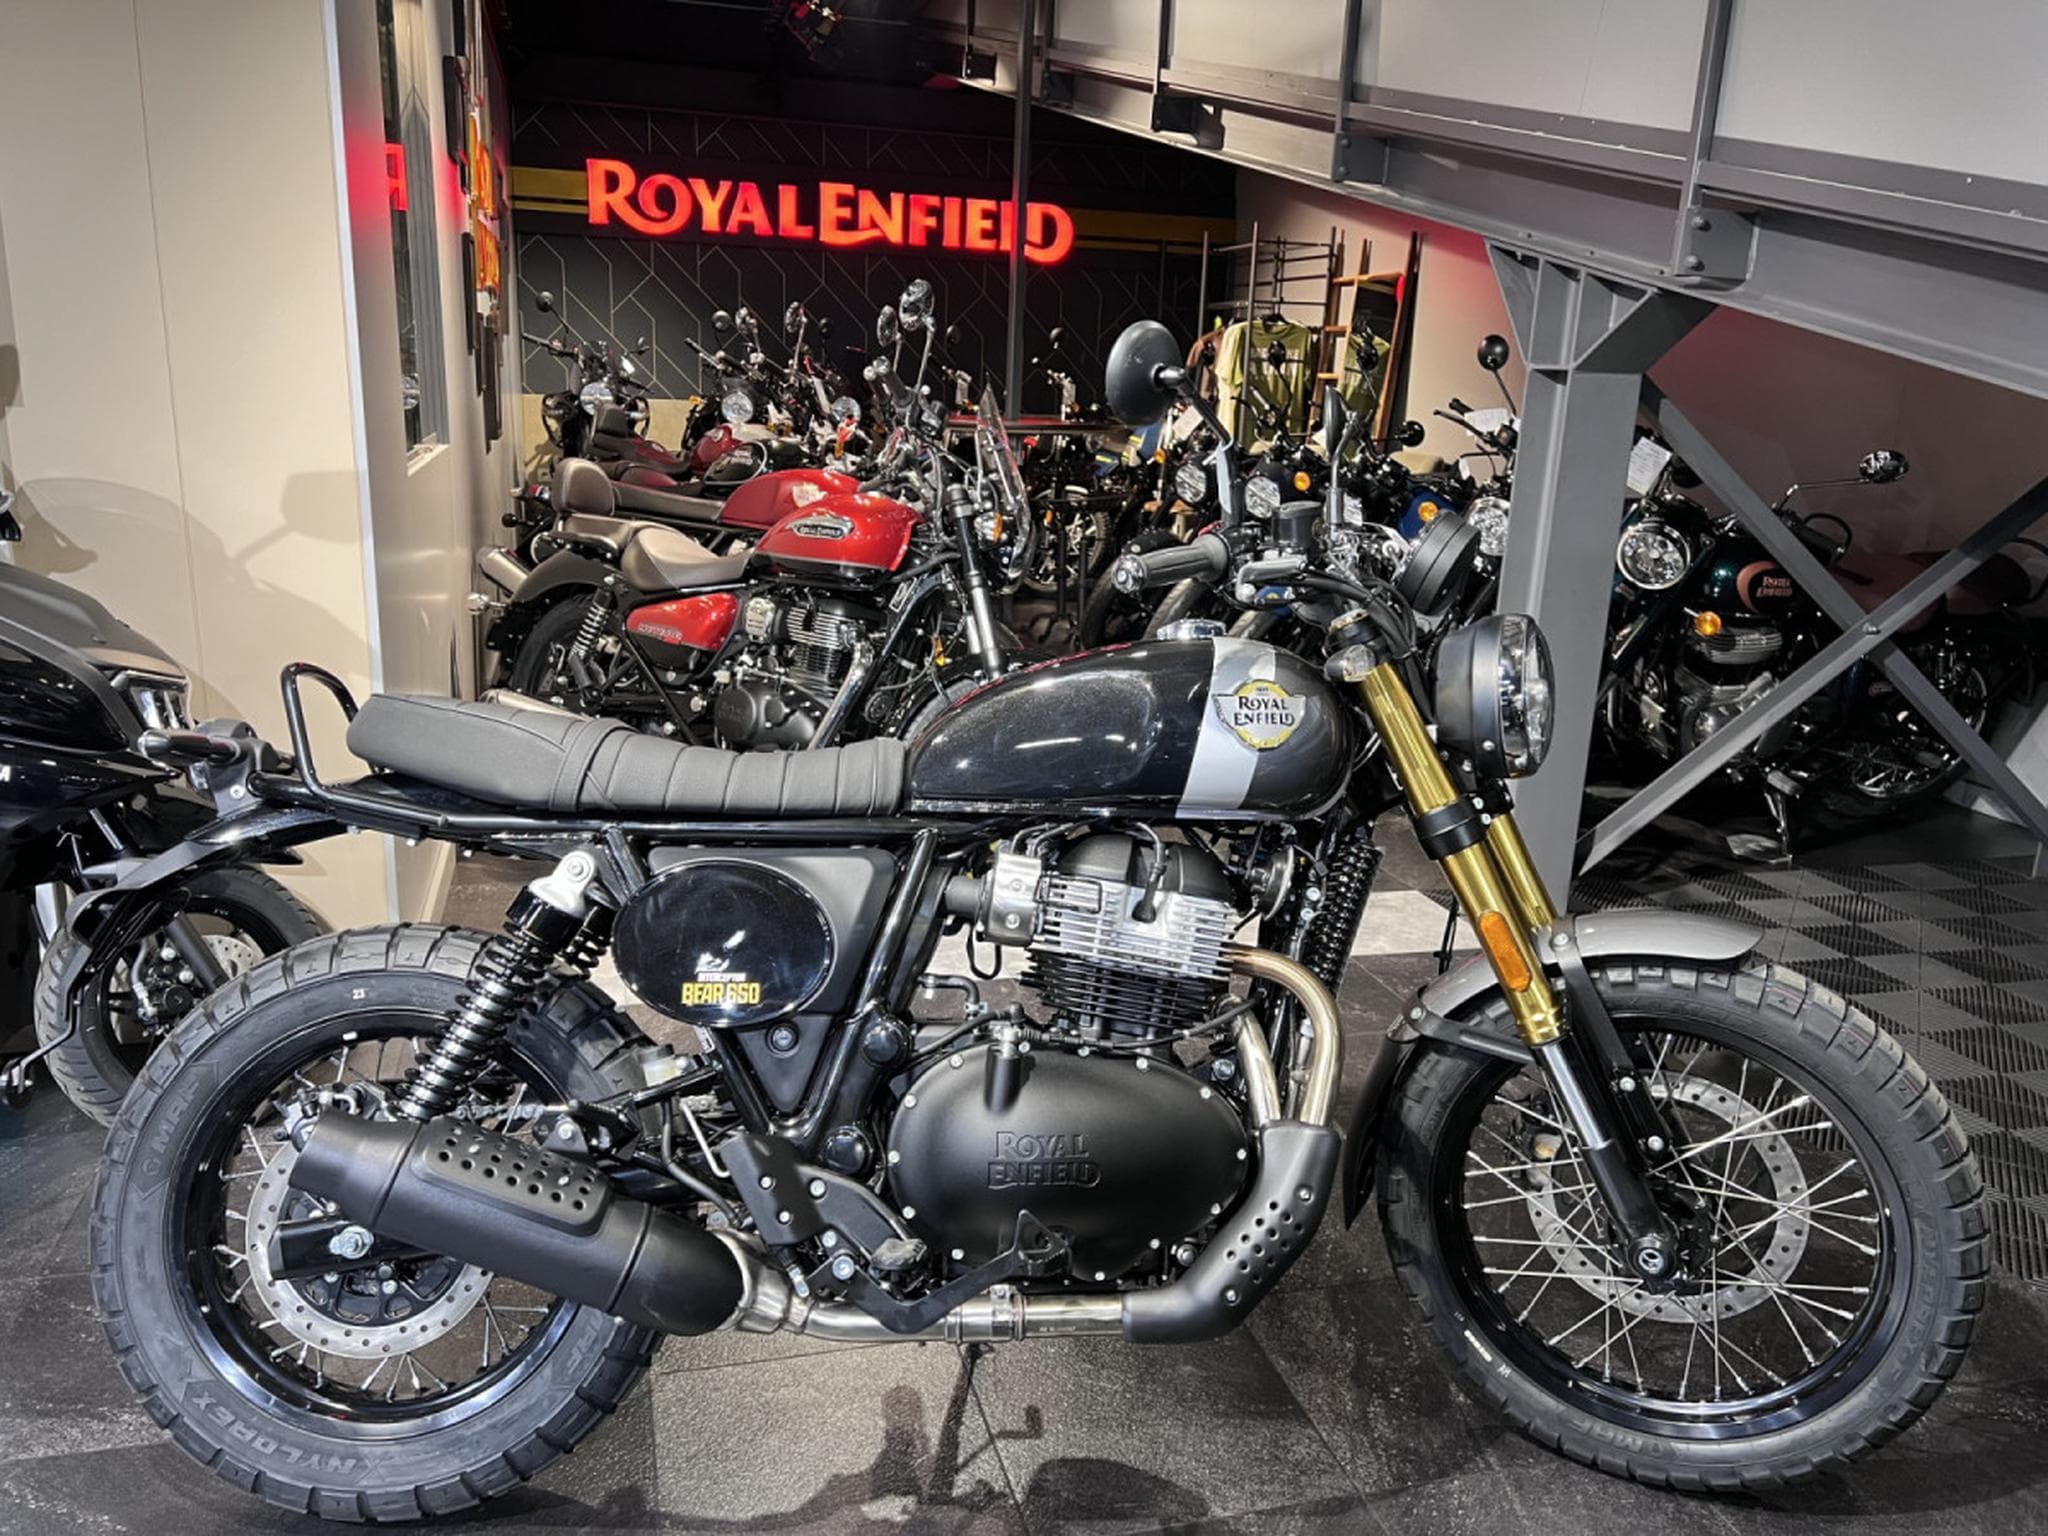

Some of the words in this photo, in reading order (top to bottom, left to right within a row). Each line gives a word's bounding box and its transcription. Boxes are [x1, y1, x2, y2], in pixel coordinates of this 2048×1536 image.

[586, 158, 815, 236] ROYAL
[818, 181, 1074, 263] ENFIELD
[1238, 696, 1288, 710] ROYAL
[1233, 713, 1295, 727] ENFIELD
[682, 983, 725, 1006] BEAR
[726, 983, 760, 1005] 650
[151, 1074, 200, 1154] MRF
[996, 1130, 1090, 1161] ROYAL
[987, 1161, 1101, 1190] ENFIELD
[193, 1390, 357, 1475] NYLOREX
